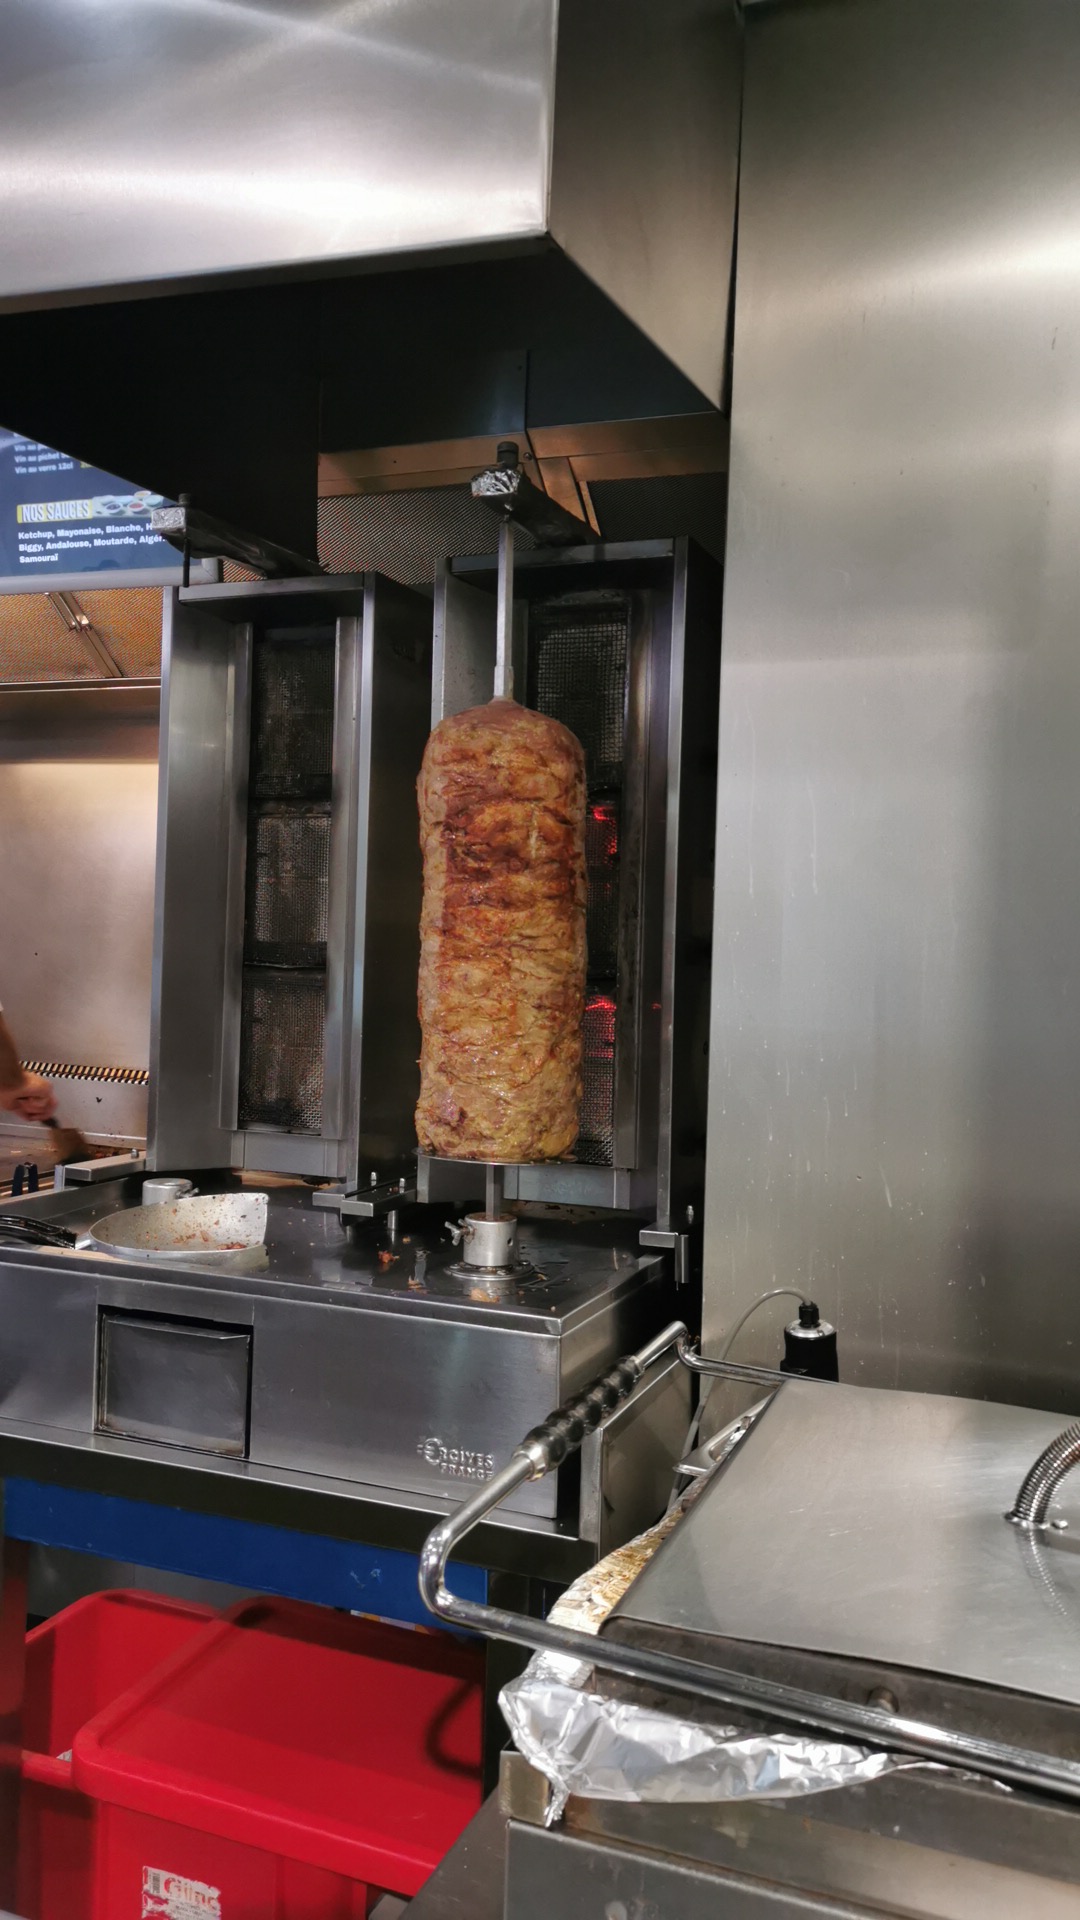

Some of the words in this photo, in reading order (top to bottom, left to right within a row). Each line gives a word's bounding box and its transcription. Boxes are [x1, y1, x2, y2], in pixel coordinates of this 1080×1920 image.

[15, 466, 27, 474] Vin
[22, 504, 44, 523] NOS
[47, 500, 89, 521] SAUCES
[18, 530, 55, 539] Ketchup,
[56, 526, 104, 538] Mayonaise,
[106, 523, 144, 534] Blanche,
[19, 543, 44, 553] Biggy,
[46, 540, 92, 550] Andalouse,
[93, 536, 137, 546] Moutarde,
